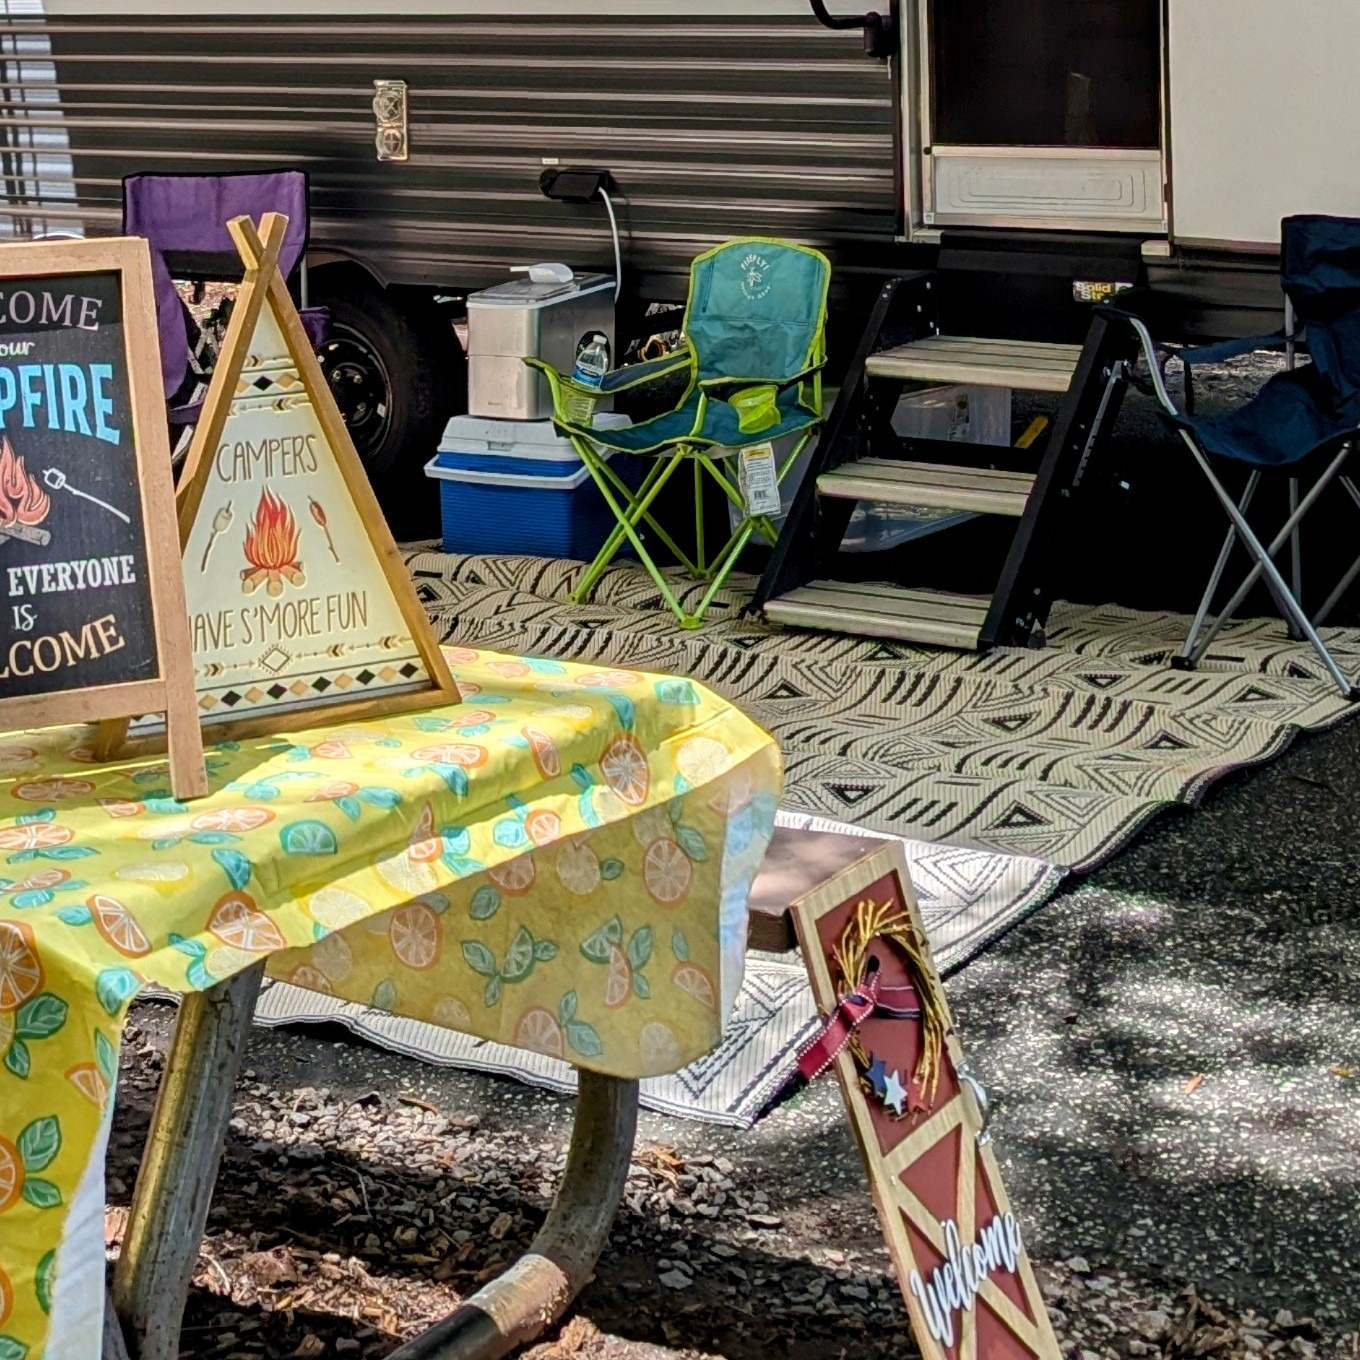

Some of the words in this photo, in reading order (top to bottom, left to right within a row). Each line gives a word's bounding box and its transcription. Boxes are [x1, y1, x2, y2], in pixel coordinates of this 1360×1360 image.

[1075, 281, 1111, 293] Solid
[216, 434, 318, 482] CAMPERS
[7, 554, 136, 597] EVERYONE
[12, 603, 37, 631] IS
[188, 609, 234, 652] AVE
[240, 597, 321, 645] S'MORE
[326, 591, 368, 632] FUN
